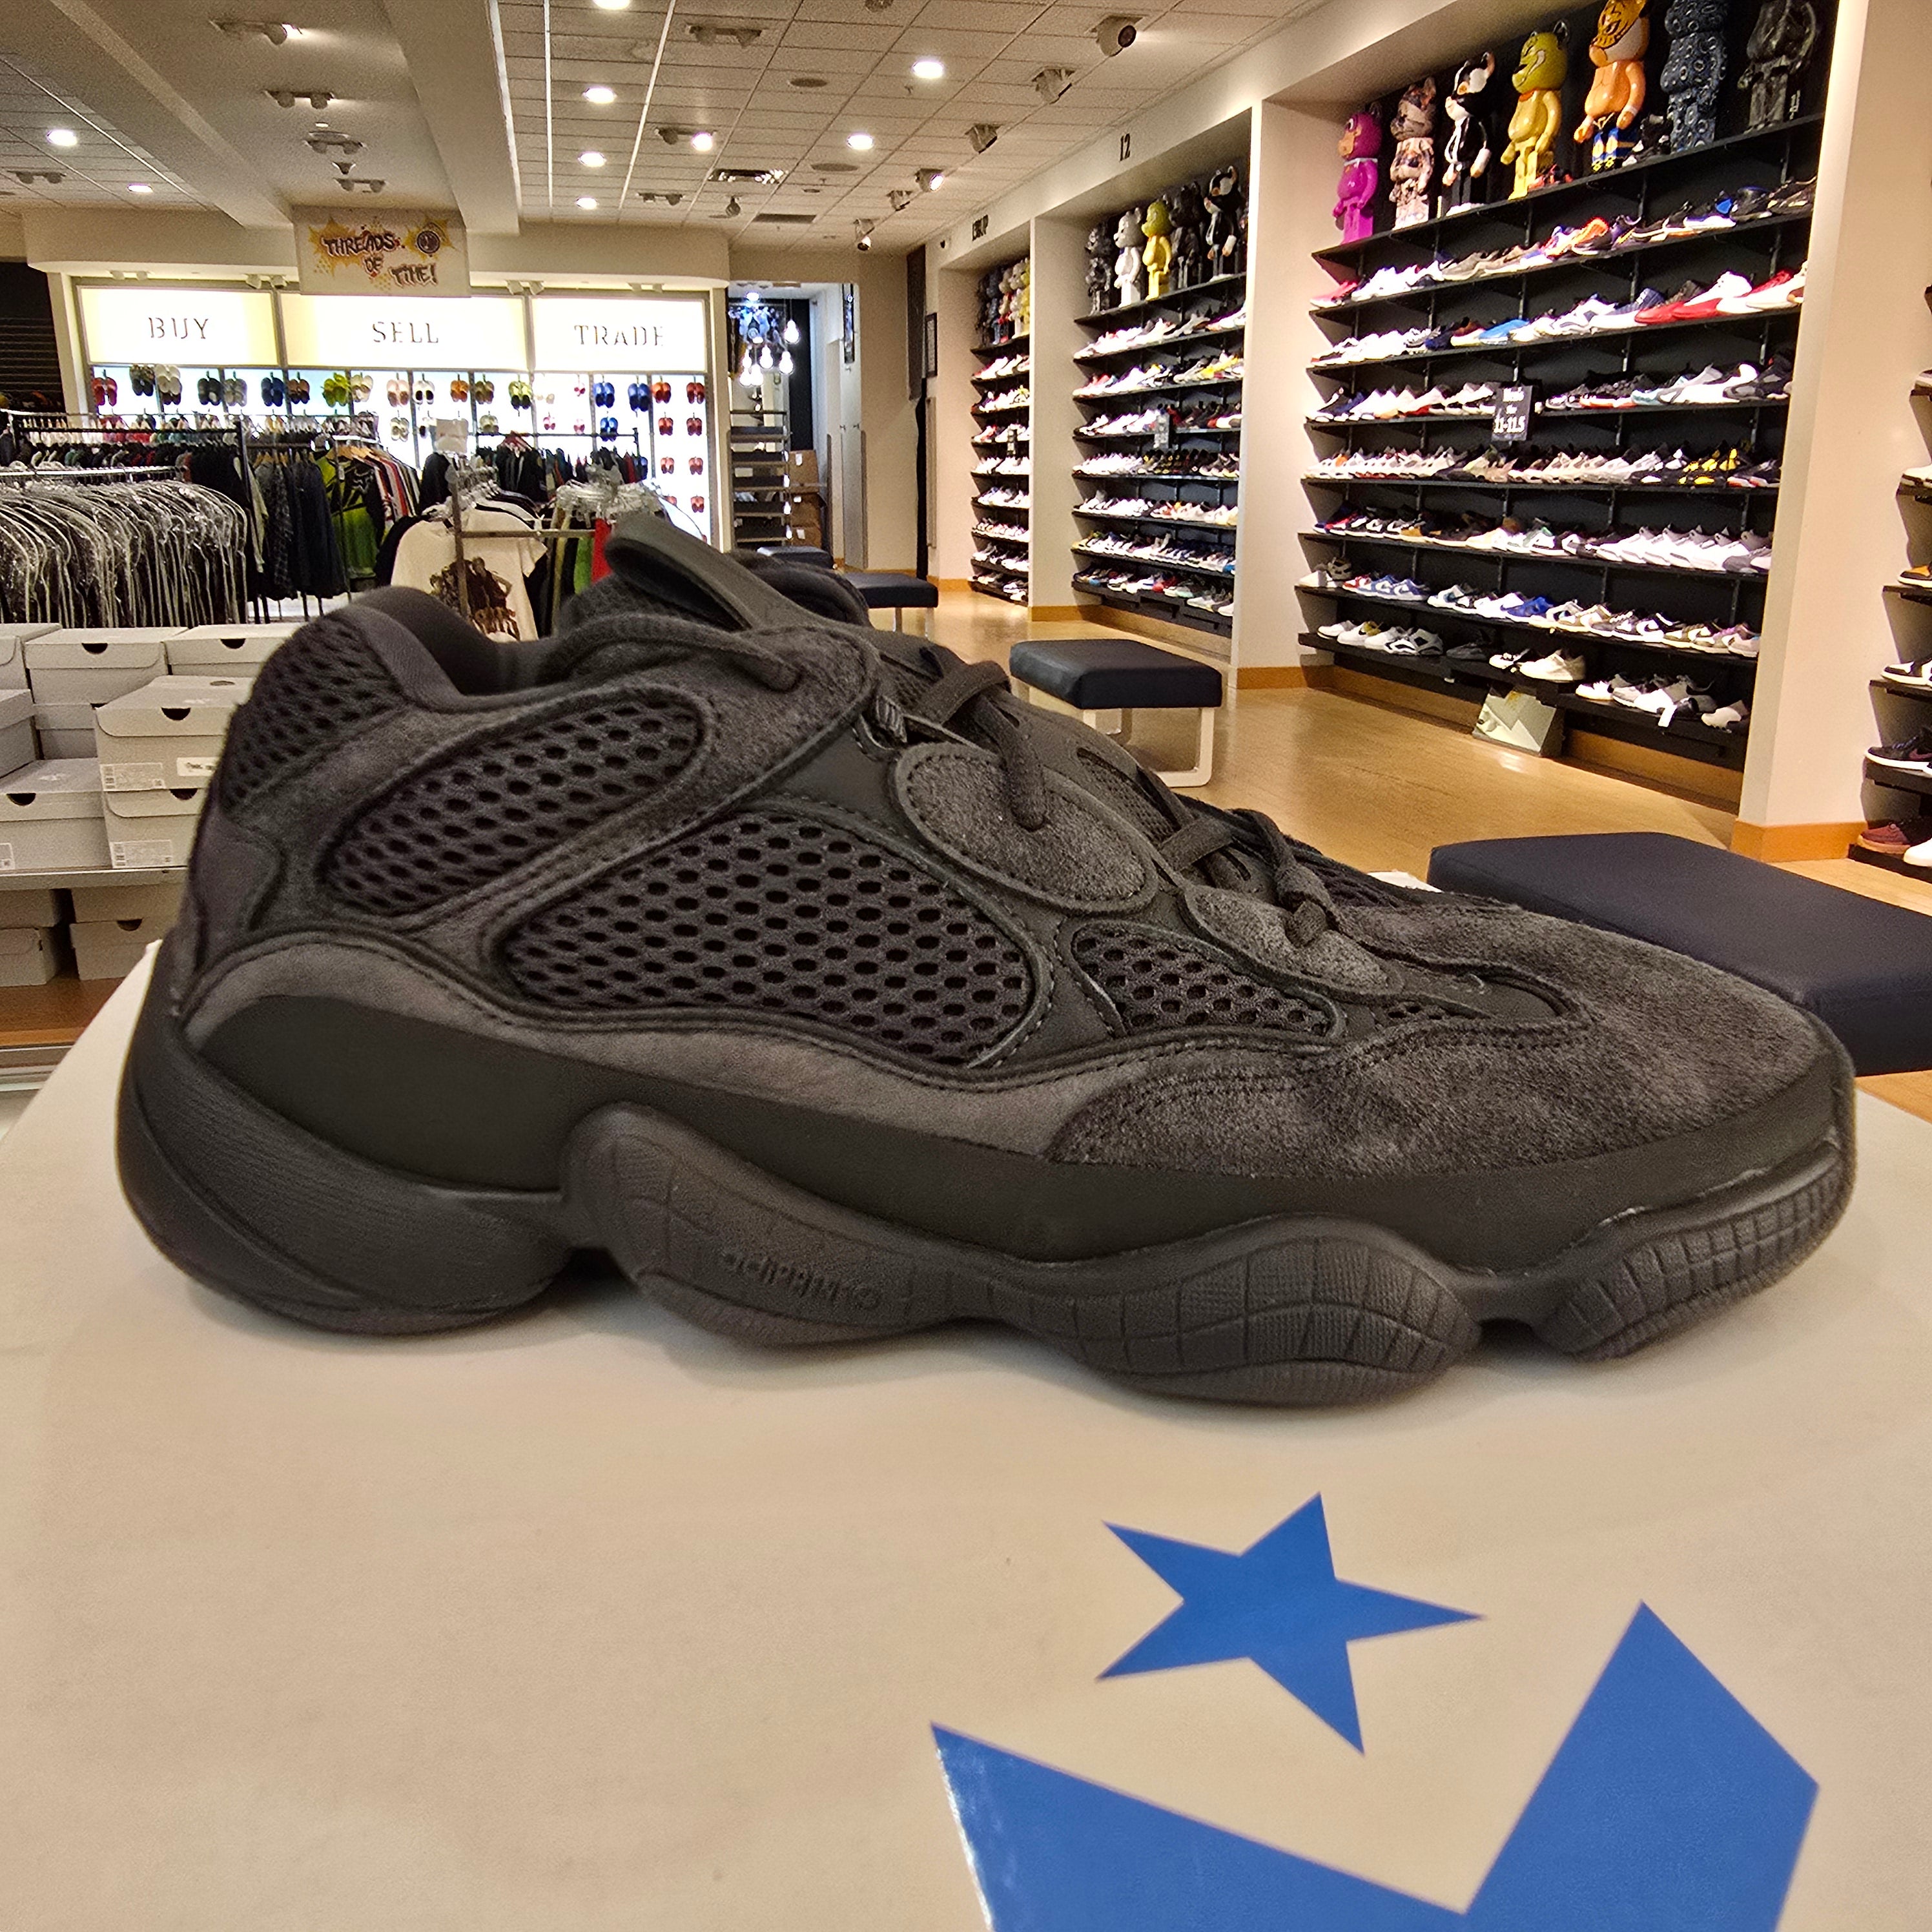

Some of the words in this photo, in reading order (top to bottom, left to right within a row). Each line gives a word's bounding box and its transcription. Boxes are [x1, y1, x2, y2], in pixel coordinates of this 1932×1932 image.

[1119, 133, 1131, 161] 12
[322, 231, 396, 257] THREADS
[363, 256, 384, 274] OF
[389, 263, 438, 287] TIME!
[148, 316, 209, 340] BUY
[372, 321, 439, 344] SELL
[573, 325, 664, 347] TRADE
